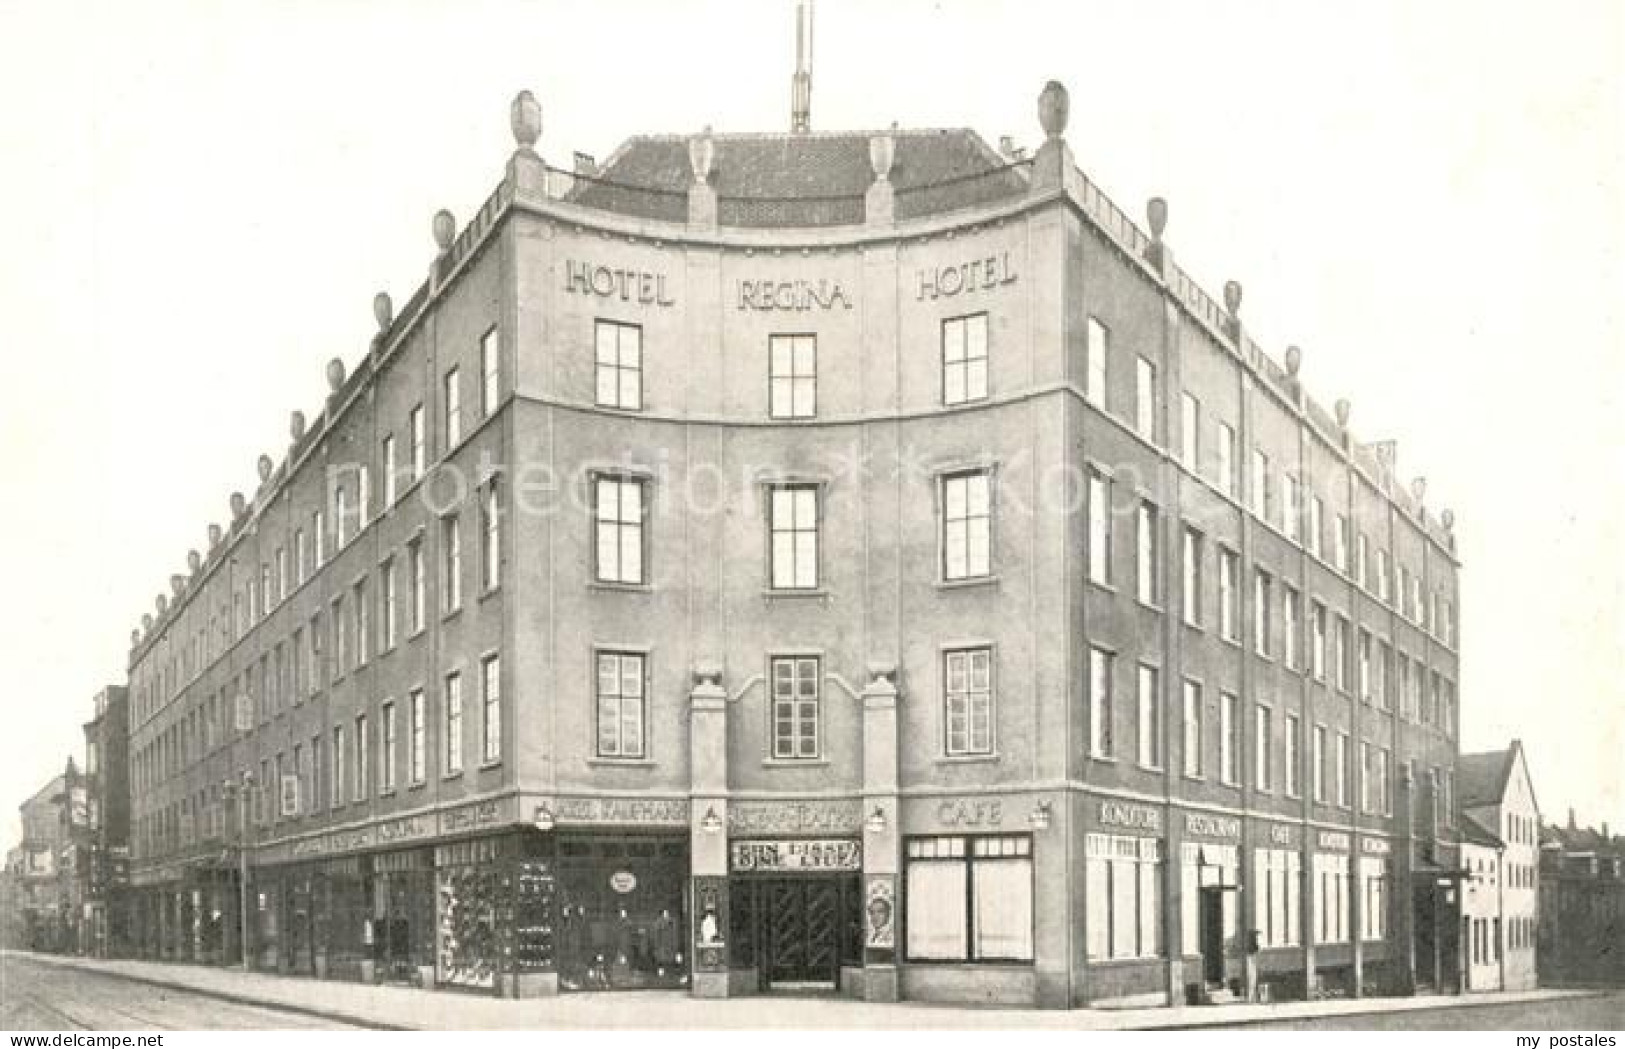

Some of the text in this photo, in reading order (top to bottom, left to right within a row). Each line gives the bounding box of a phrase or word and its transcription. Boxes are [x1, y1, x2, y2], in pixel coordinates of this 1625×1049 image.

[565, 251, 1018, 312] HOTEL REGINA HOTEL
